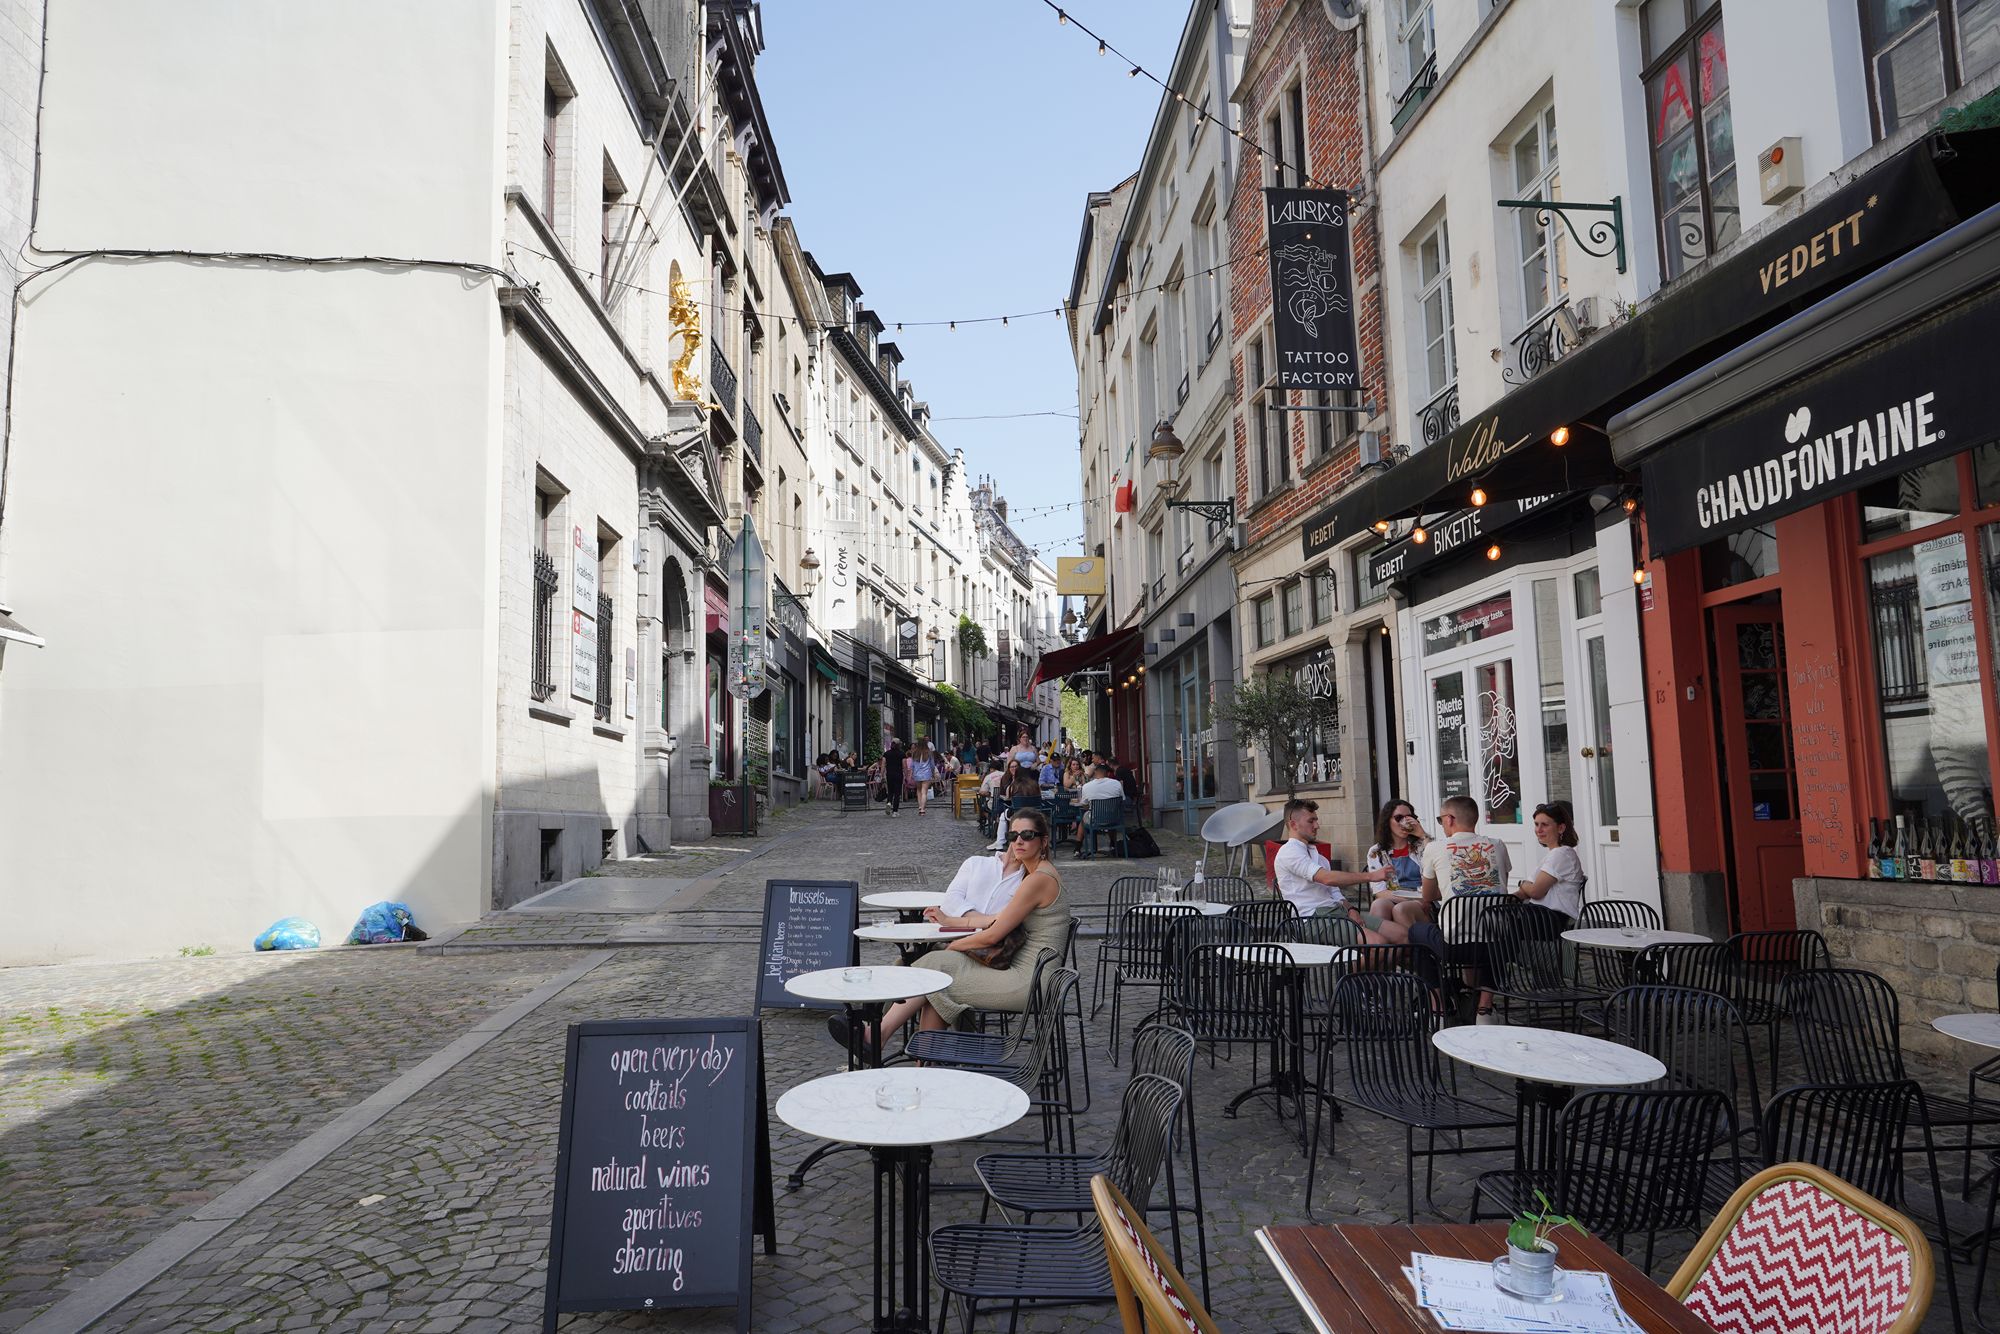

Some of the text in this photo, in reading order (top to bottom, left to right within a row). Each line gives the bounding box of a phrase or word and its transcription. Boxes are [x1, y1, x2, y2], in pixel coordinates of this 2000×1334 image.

[1271, 199, 1344, 227] LAURA'S
[1759, 209, 1865, 295] VEDETT
[1284, 351, 1349, 365] TATTOO
[1282, 372, 1355, 385] FACTORY
[1517, 492, 1562, 513] VEDE
[1309, 521, 1335, 547] VEDETT
[1433, 508, 1482, 556] BIKETTE
[832, 546, 848, 587] Crème
[1375, 555, 1404, 581] VEDETT
[1436, 699, 1463, 715] Bikette
[1656, 689, 1666, 704] 13
[1341, 725, 1347, 735] 17
[1437, 714, 1463, 730] Burger
[1446, 842, 1494, 855] ラーメン
[789, 887, 825, 905] brussels
[610, 1047, 650, 1086] open
[624, 1079, 687, 1112] cocktails
[639, 1114, 686, 1150] beers
[591, 1154, 710, 1192] natural wines
[622, 1194, 703, 1244] aperitives
[612, 1237, 685, 1292] sharing
